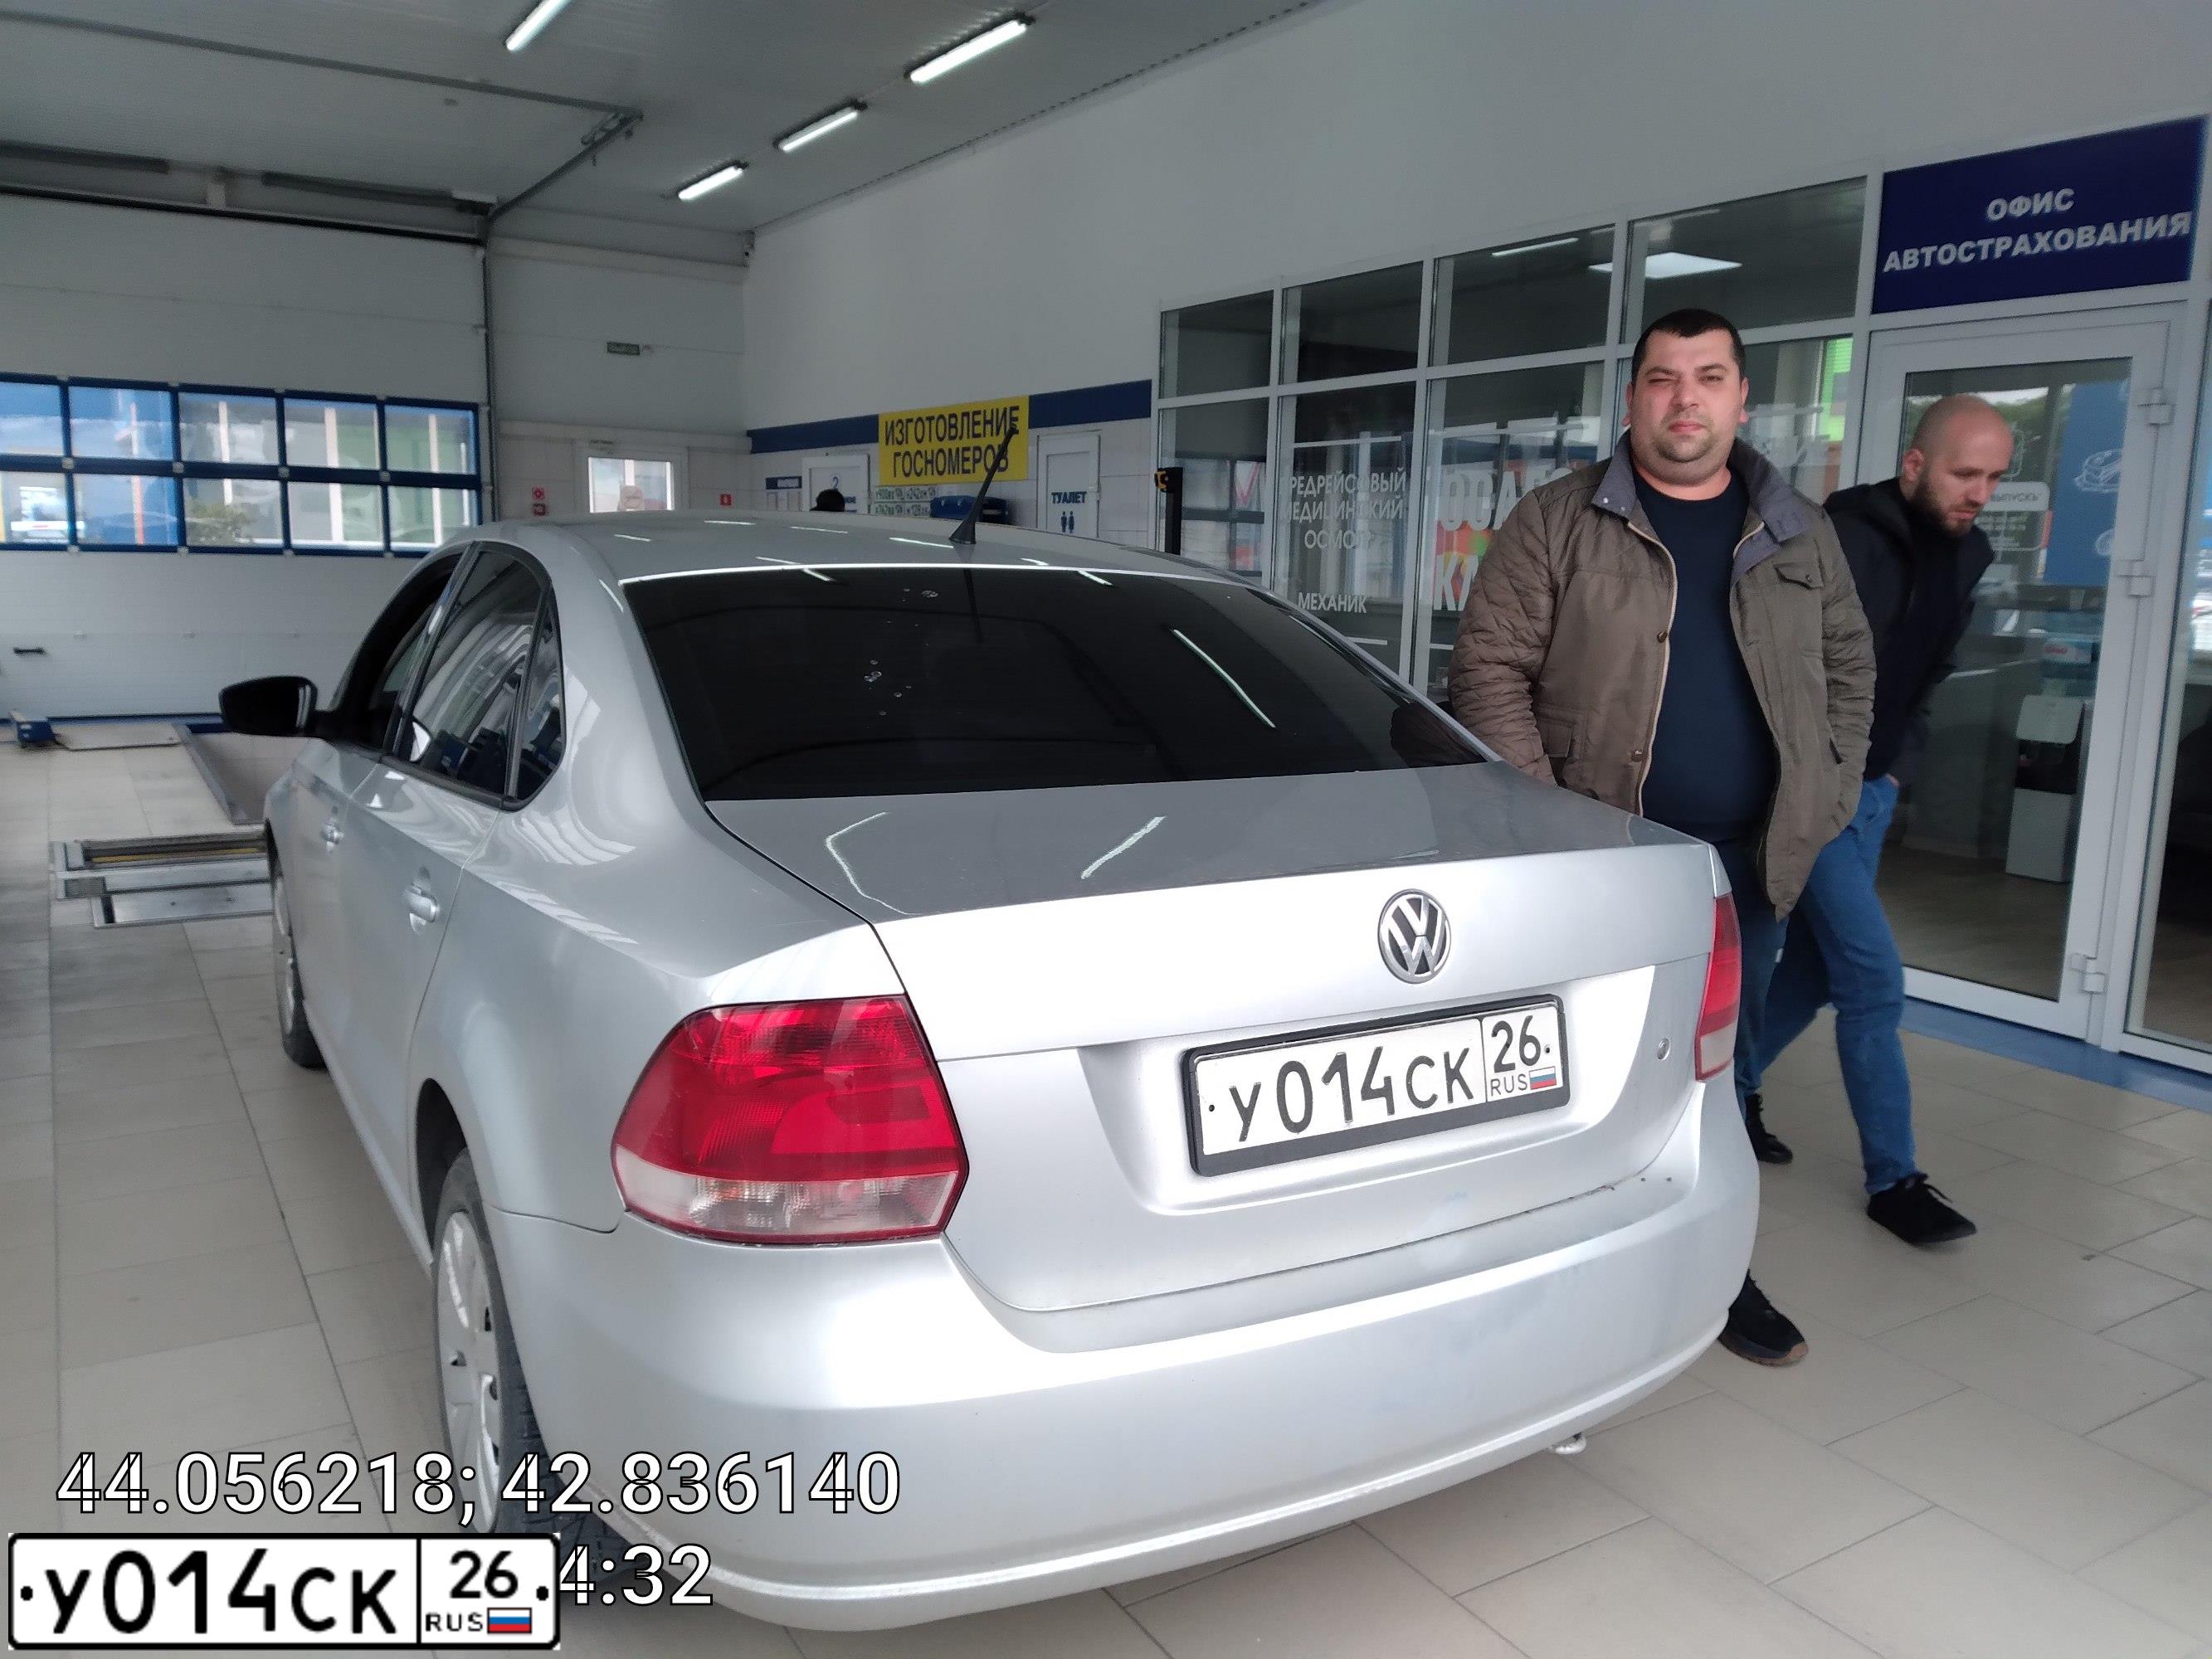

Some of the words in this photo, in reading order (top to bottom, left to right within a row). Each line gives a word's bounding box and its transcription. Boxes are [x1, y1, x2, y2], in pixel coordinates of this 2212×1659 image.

[1986, 187, 2075, 221] ОФИС
[1883, 212, 2194, 273] АВТОСТРАХОВАНИЯ
[884, 406, 1020, 446] ИЗГОТОВЛЕНИЕ
[1050, 491, 1088, 504] ТУАЛЕТ
[1289, 467, 1407, 498] РЕДРЕЙСОВЫЙ
[1289, 495, 1403, 523] ЕДИЦИНСКИЙ
[1298, 591, 1367, 614] МЕХАНИК
[1491, 1014, 1542, 1073] 26
[1490, 1073, 1528, 1097] RUS
